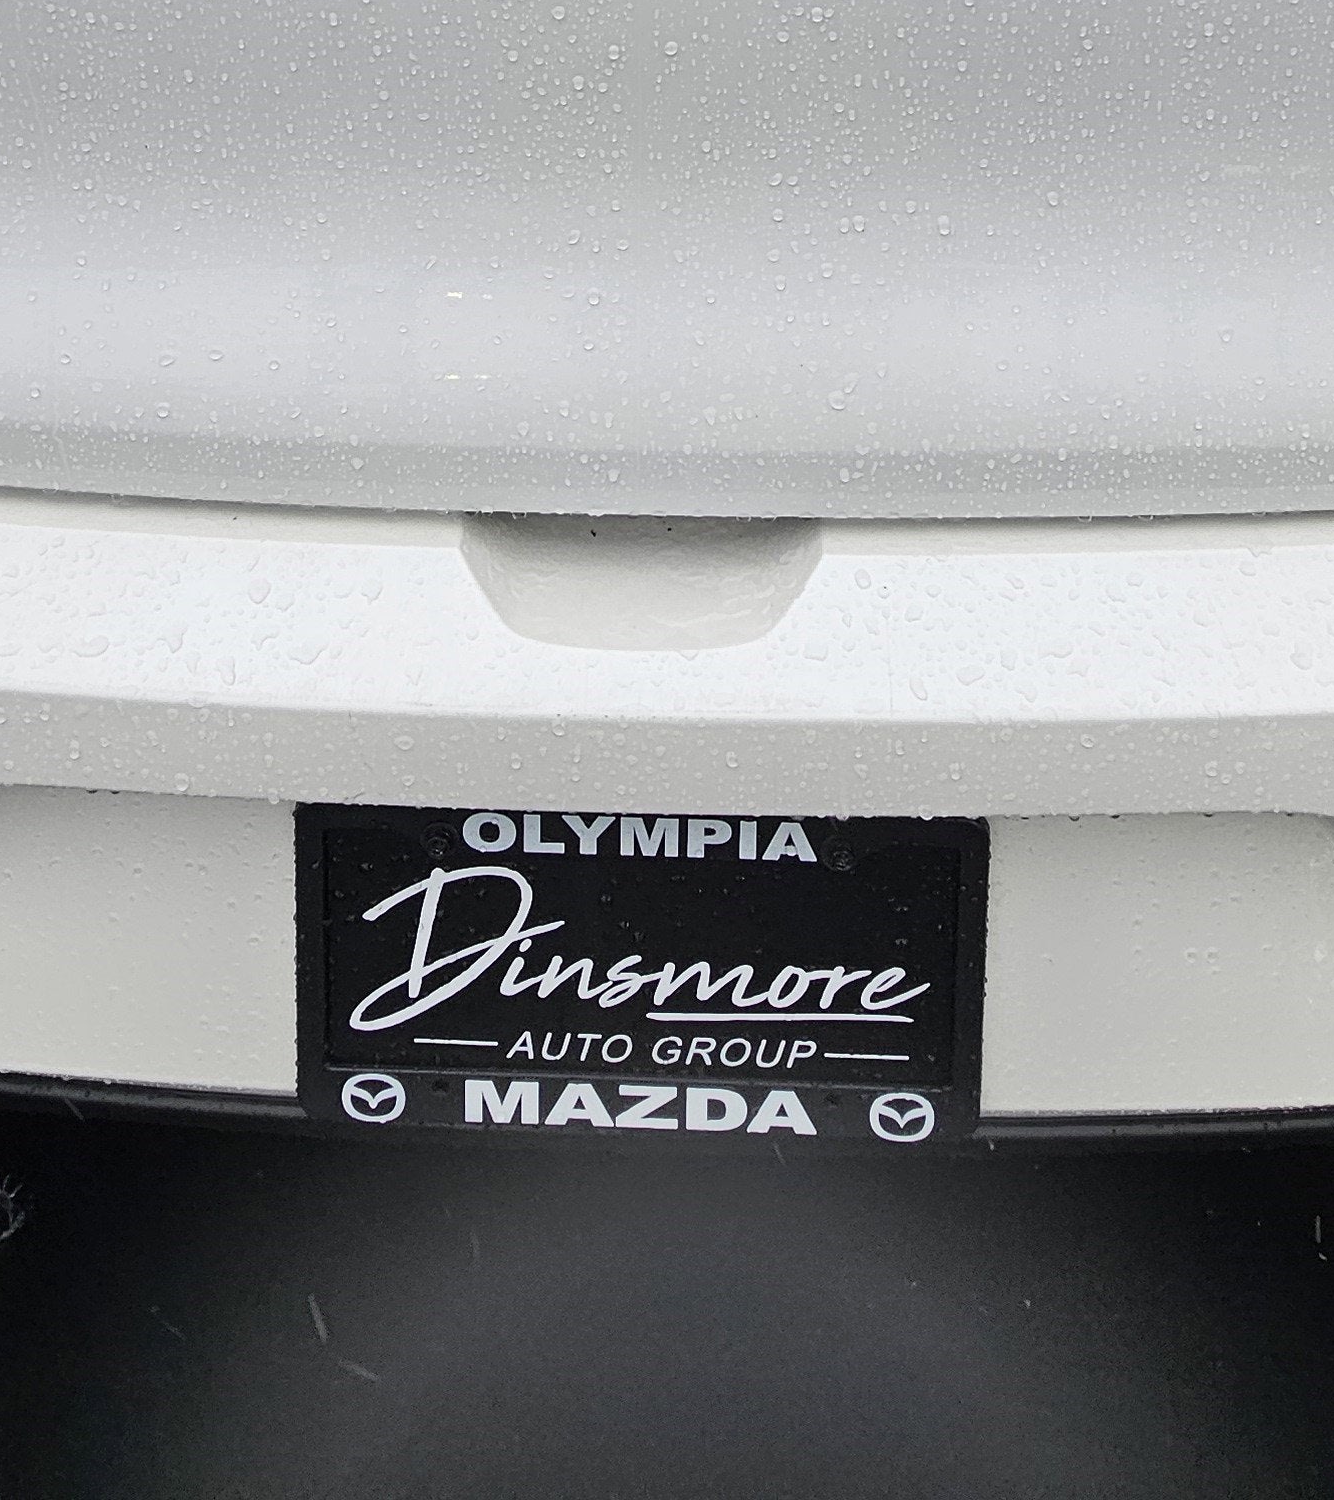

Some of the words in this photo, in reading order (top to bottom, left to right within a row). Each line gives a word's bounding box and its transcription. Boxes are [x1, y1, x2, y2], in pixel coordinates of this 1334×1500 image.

[462, 812, 818, 862] OLYMPIA
[349, 865, 931, 1031] Dinsmore
[505, 1030, 633, 1064] AUTO
[651, 1035, 818, 1069] GROUP
[464, 1079, 818, 1136] MAZDA
